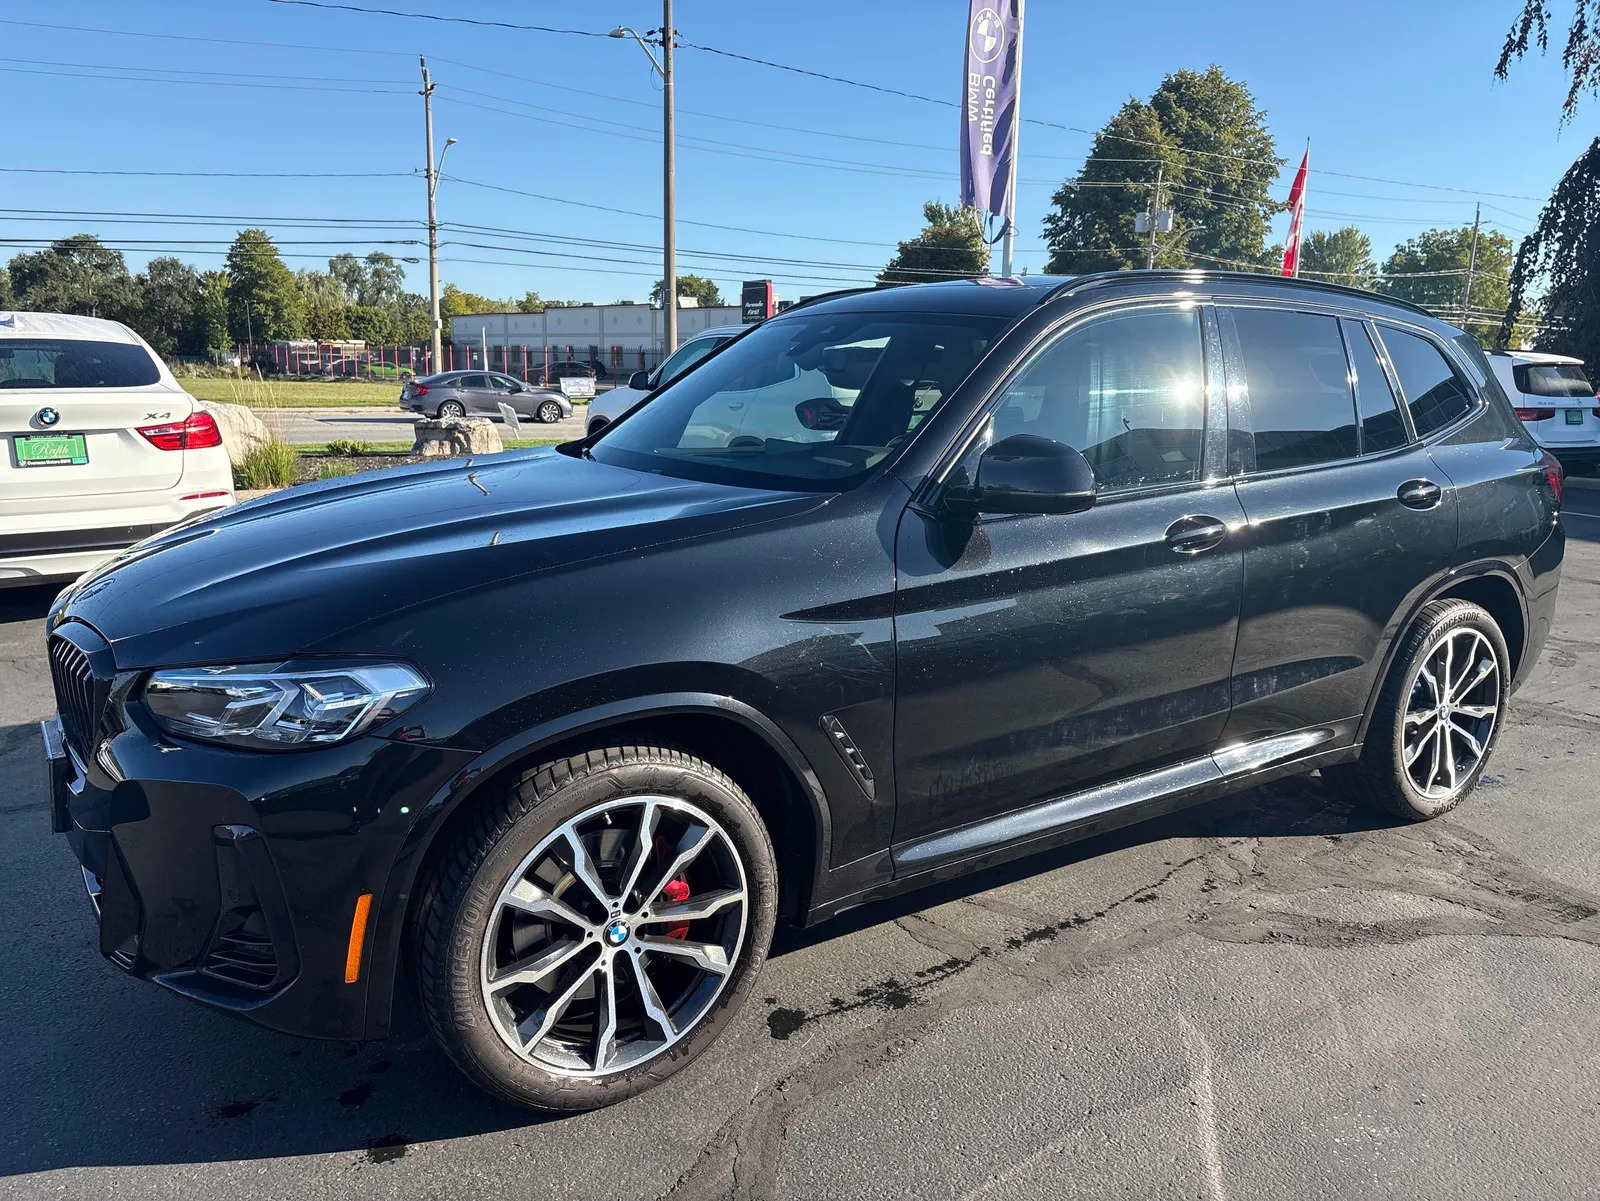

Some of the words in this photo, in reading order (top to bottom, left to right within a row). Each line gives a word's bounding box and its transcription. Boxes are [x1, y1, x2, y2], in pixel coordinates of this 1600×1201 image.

[142, 411, 172, 421] X4
[1428, 611, 1480, 647] BRIDGESTONE
[452, 879, 495, 1031] BRIDGESTONE
